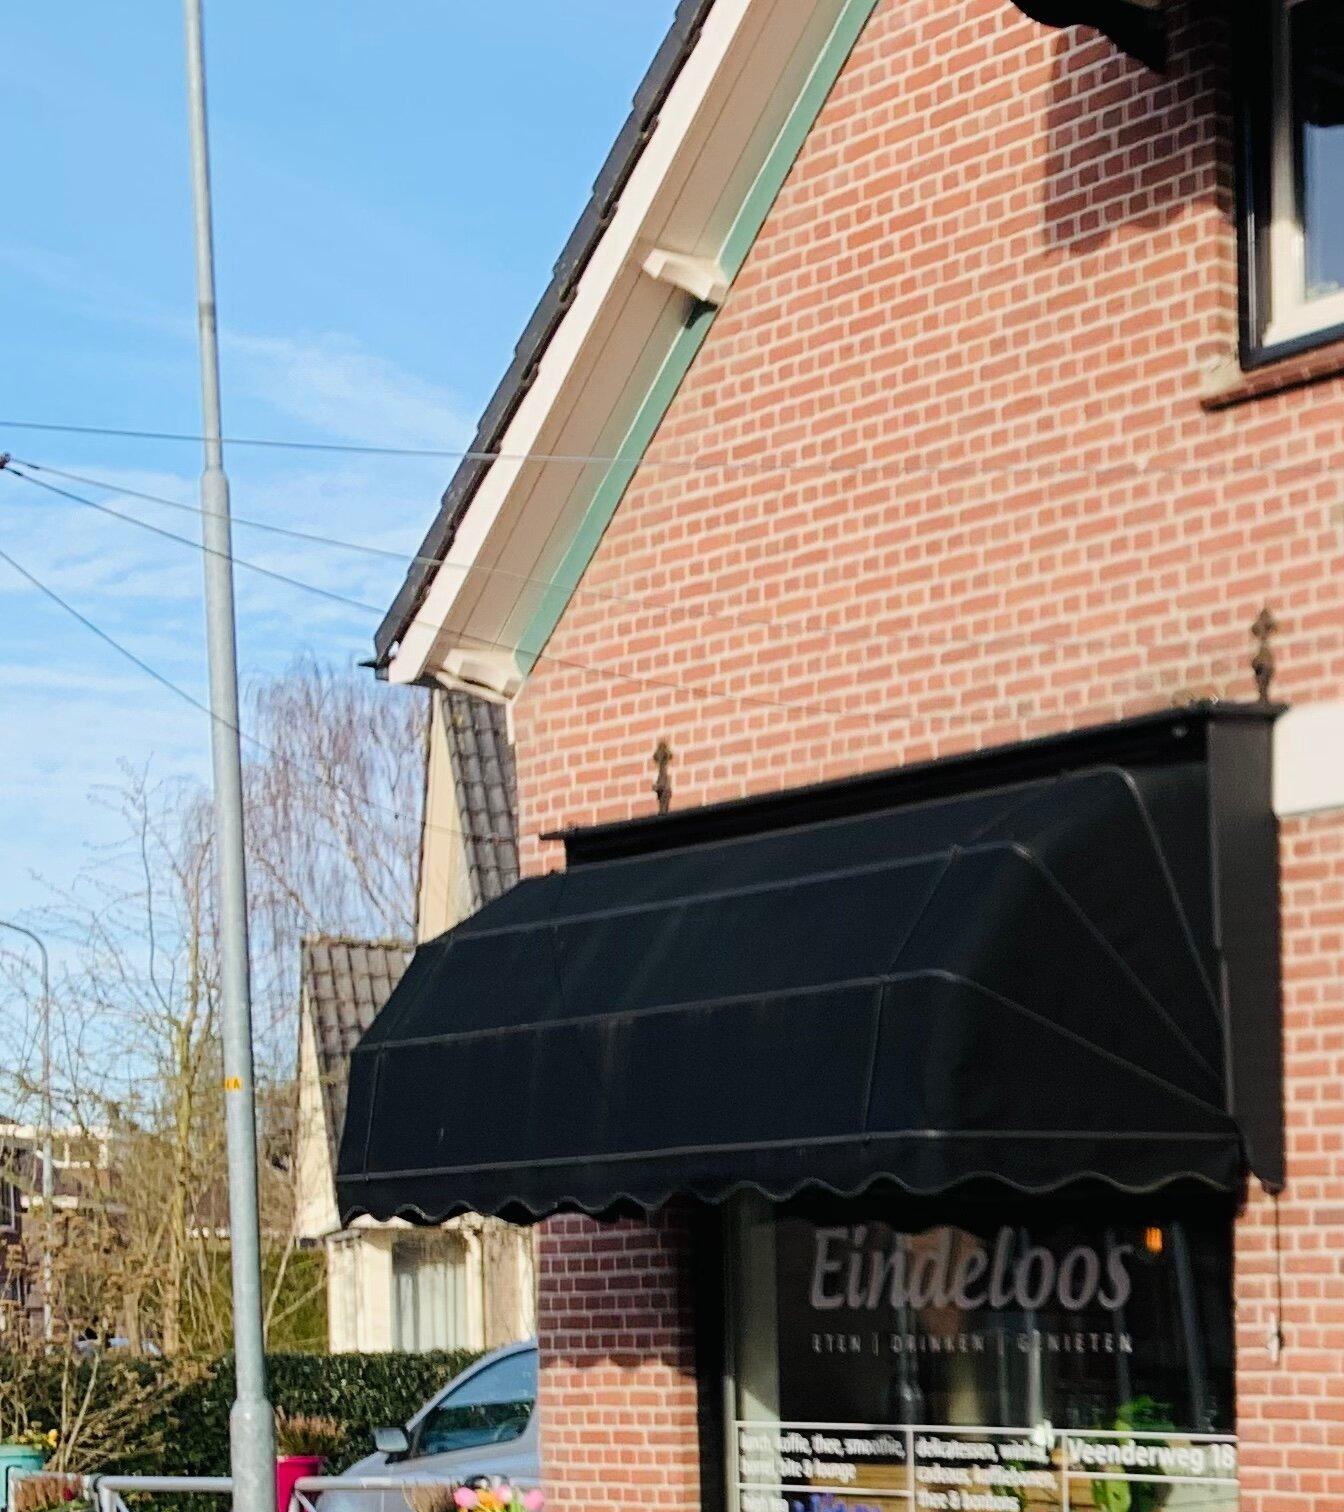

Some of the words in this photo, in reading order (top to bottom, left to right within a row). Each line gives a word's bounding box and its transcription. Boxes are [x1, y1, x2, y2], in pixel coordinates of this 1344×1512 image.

[812, 1225, 1135, 1310] Eindeloos
[1068, 1438, 1204, 1474] Veenderweg
[1208, 1443, 1236, 1471] 18
